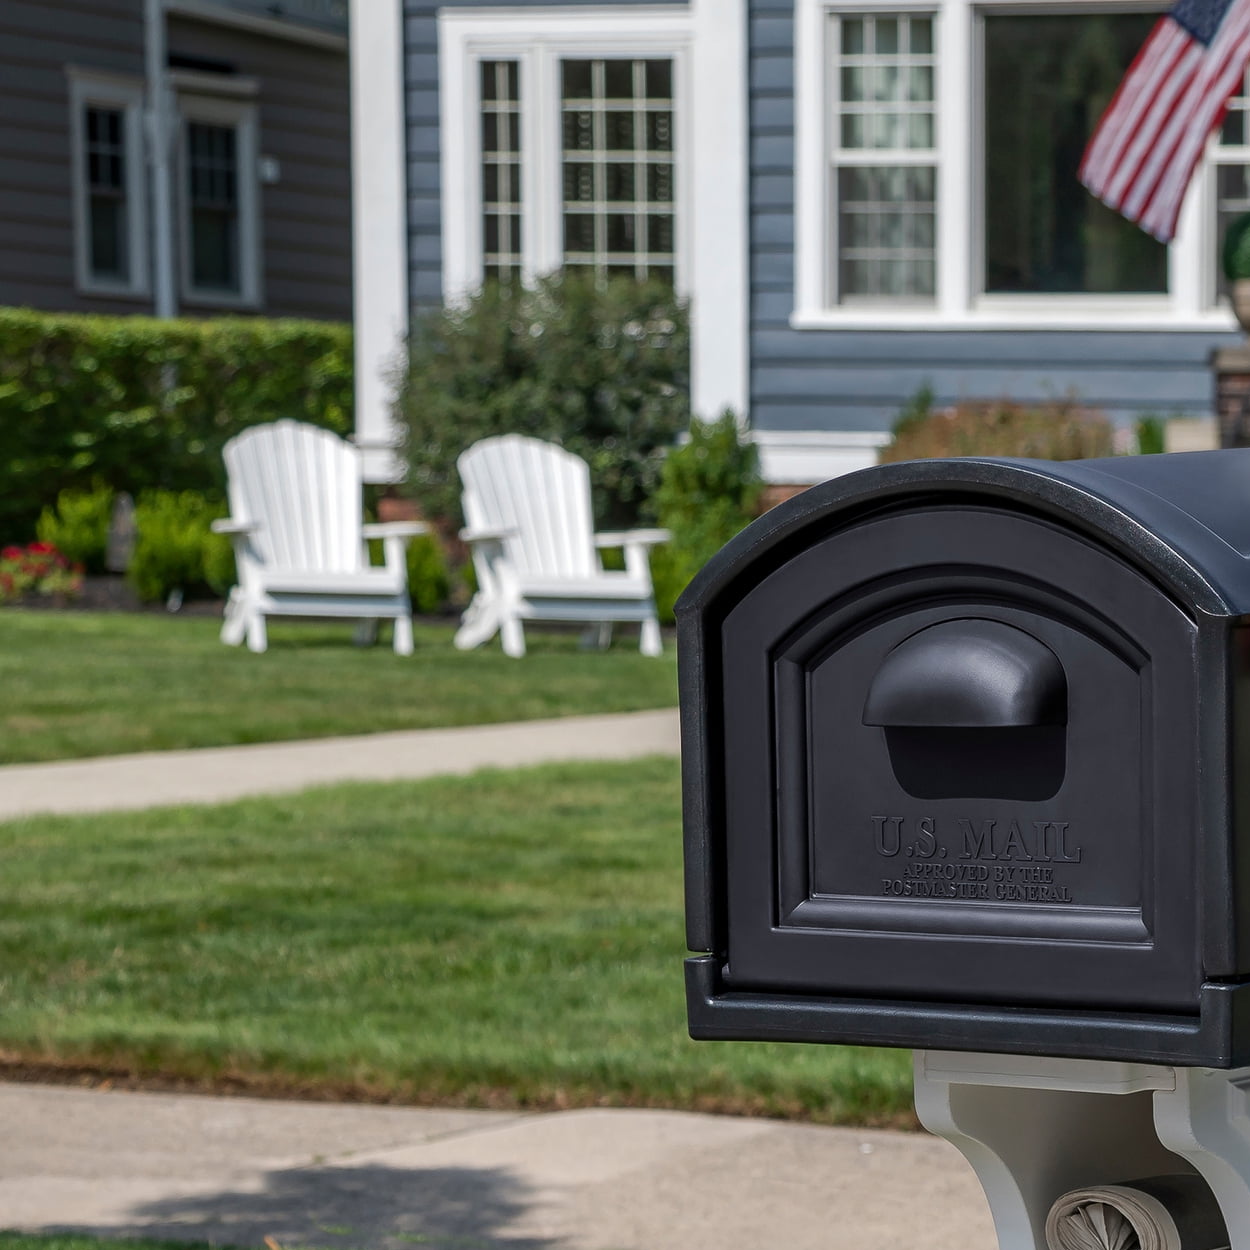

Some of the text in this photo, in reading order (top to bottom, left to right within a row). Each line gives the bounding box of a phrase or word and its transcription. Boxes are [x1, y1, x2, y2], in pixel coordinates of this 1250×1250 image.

[871, 815, 1082, 863] U.S. MAIL
[903, 863, 1054, 884] APPROVED BY THE
[882, 879, 1073, 902] POSTMASTER GENERAL
